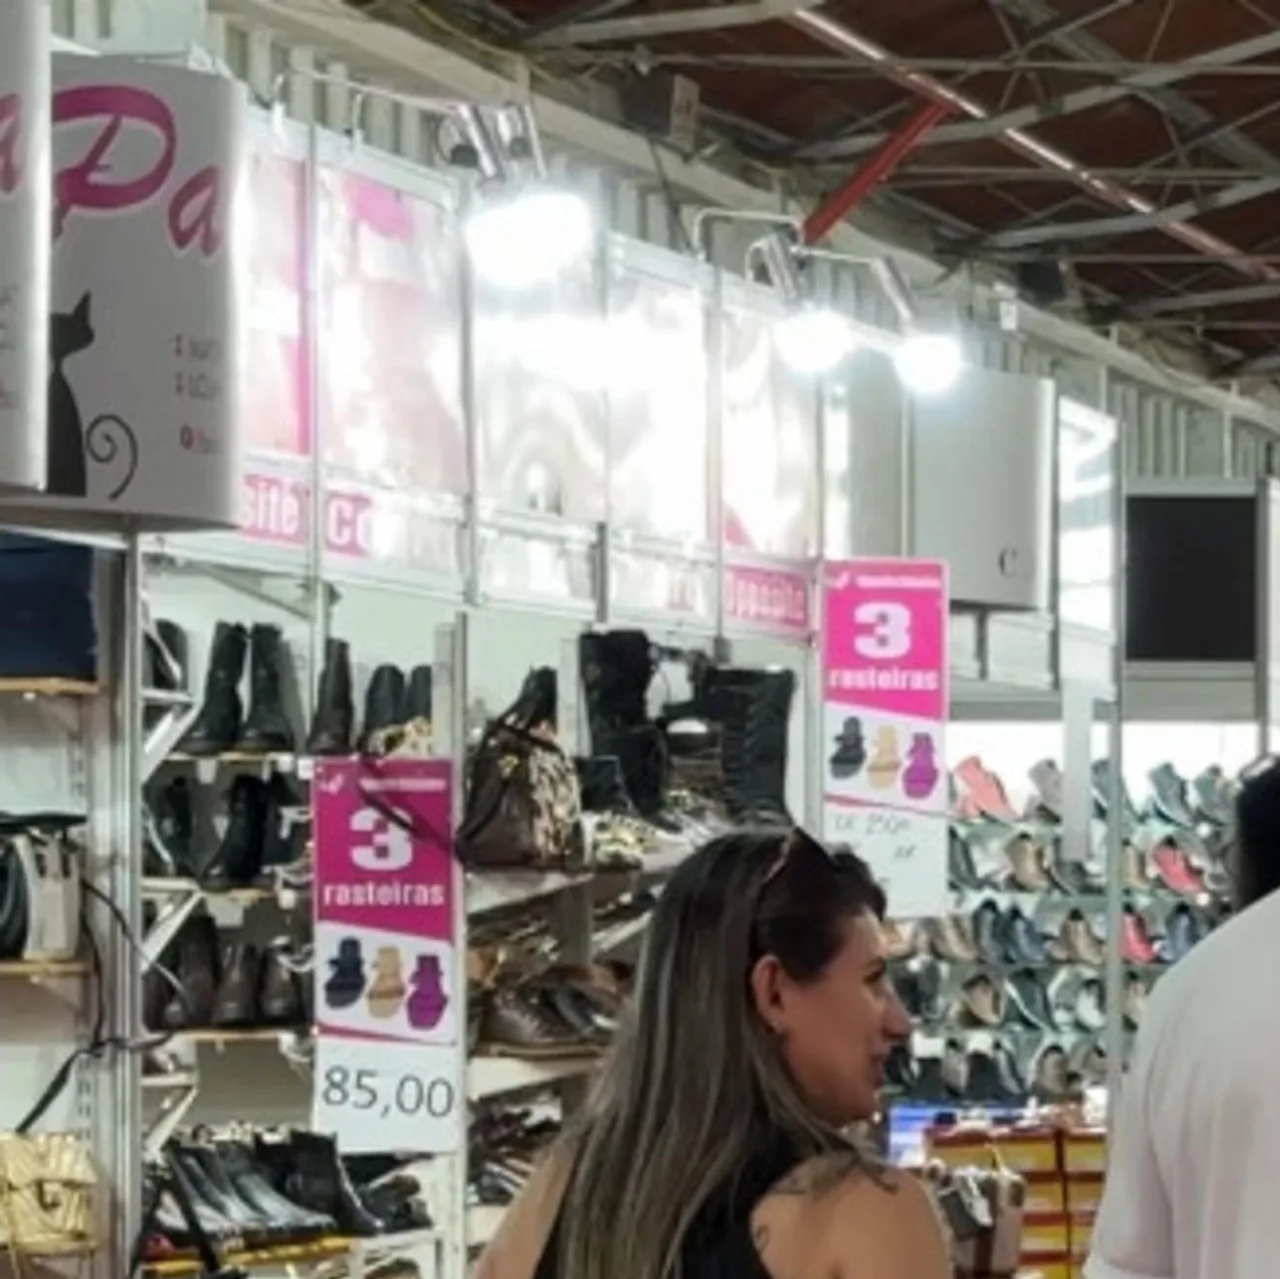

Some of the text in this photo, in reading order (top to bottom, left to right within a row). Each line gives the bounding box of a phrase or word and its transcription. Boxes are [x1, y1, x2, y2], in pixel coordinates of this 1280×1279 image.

[854, 602, 912, 660] 3
[829, 668, 939, 690] rasteiras
[350, 806, 414, 871] 3
[323, 881, 445, 907] rasteiras
[322, 1064, 455, 1119] 85,00
